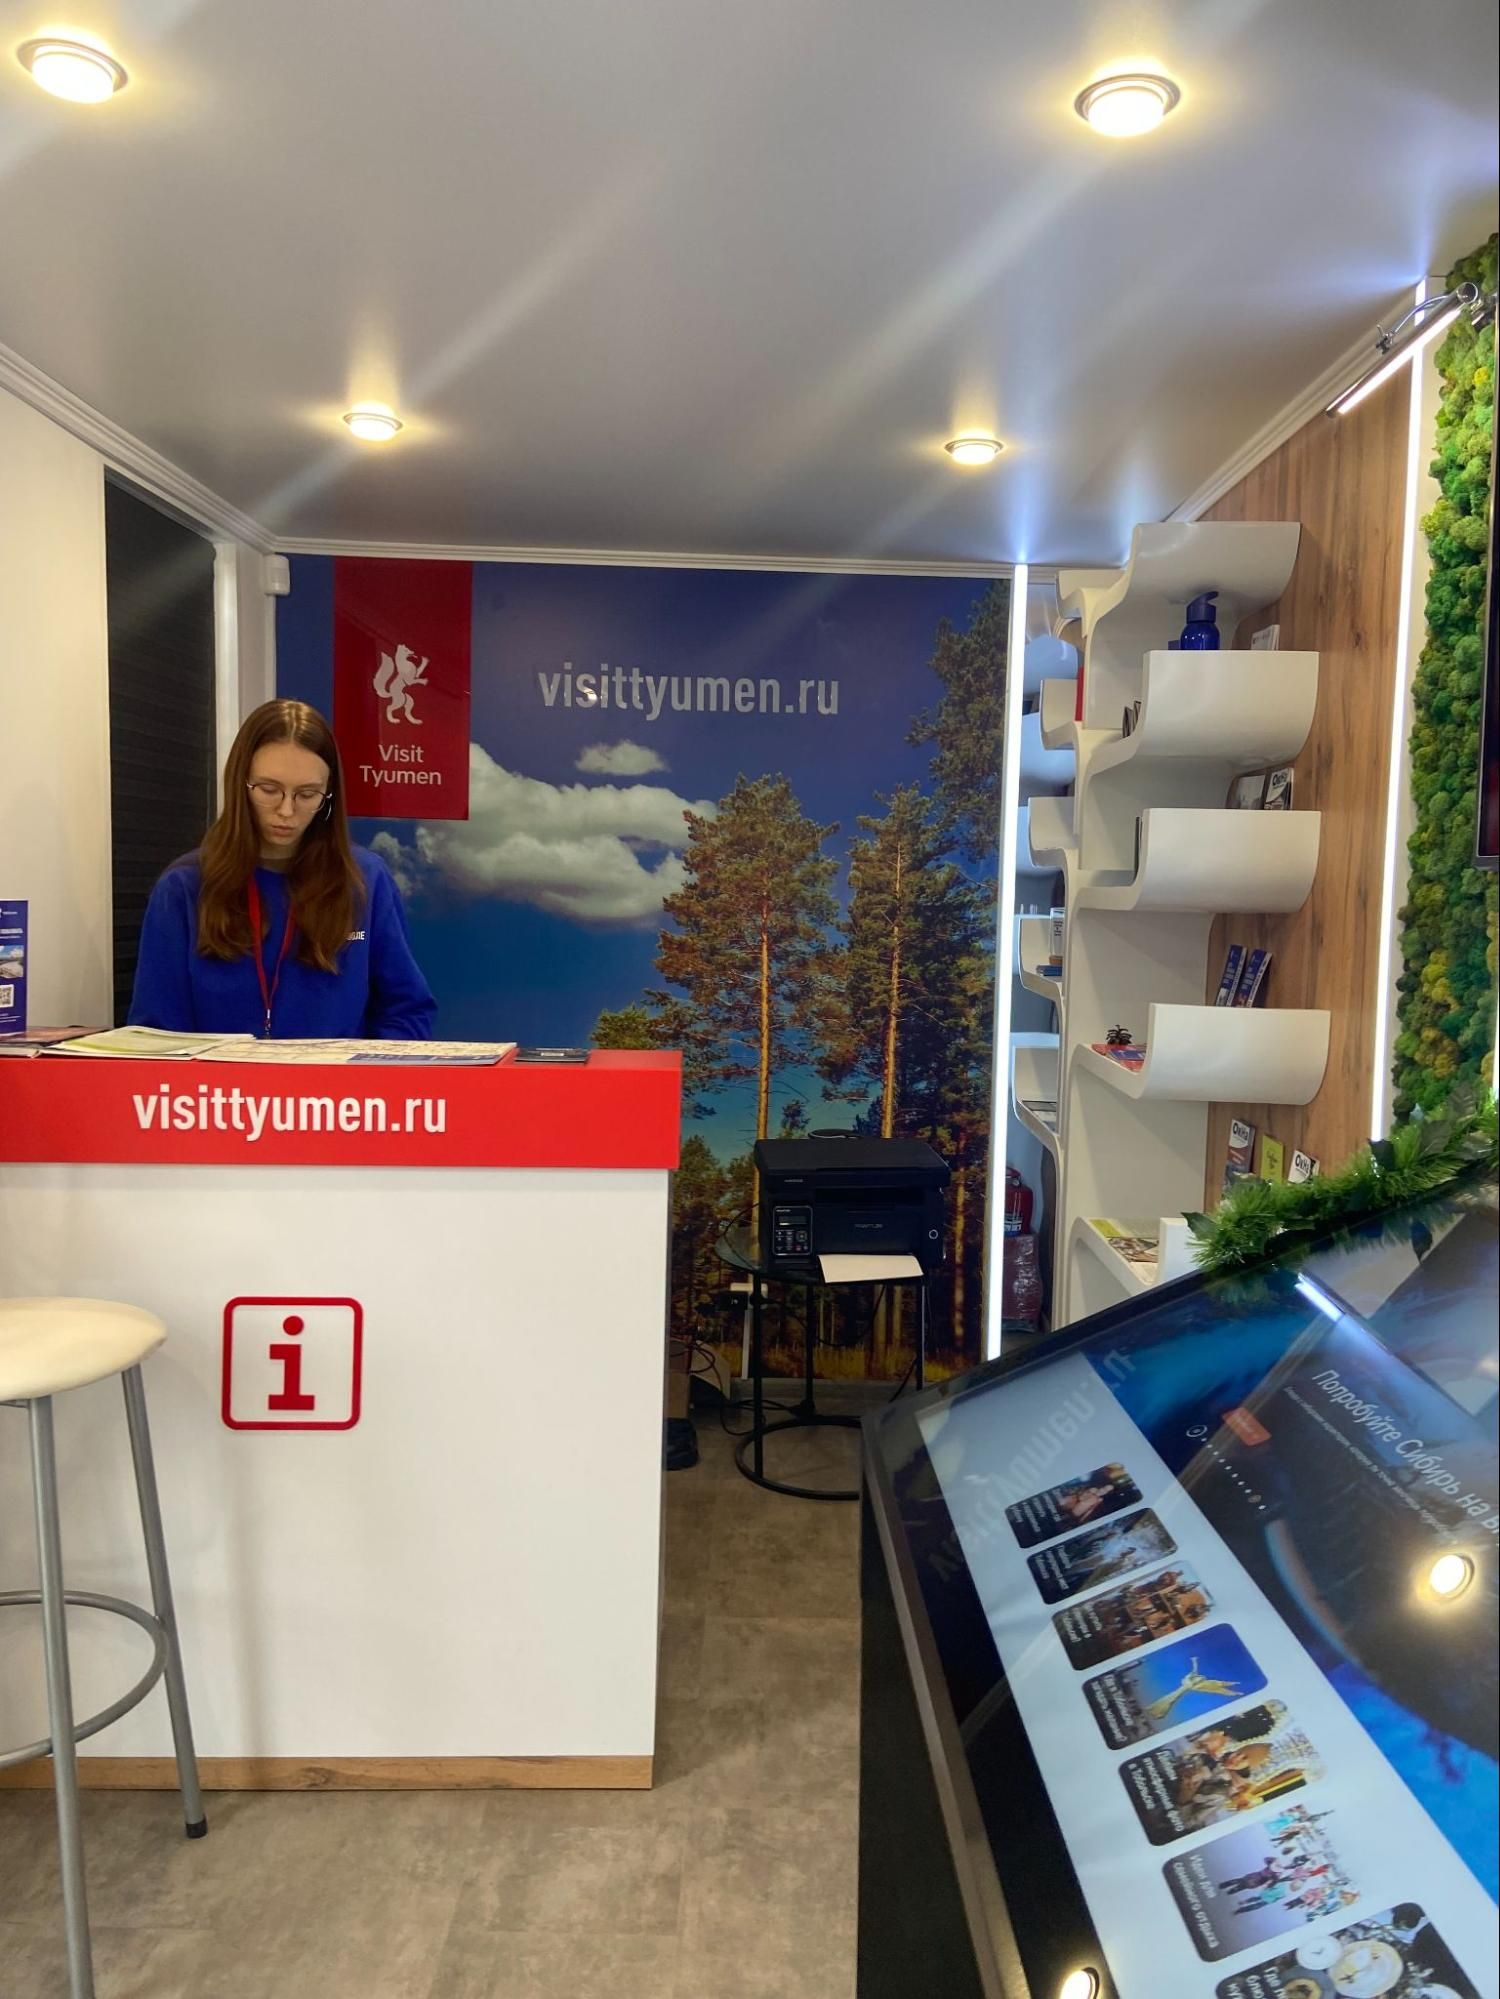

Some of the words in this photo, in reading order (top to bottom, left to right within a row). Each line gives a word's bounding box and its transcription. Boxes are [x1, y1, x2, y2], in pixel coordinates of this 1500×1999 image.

[537, 661, 839, 721] visittyumen.ru
[378, 744, 424, 763] Visit
[359, 765, 441, 788] Tyumen
[132, 1083, 446, 1142] visittyumen.ru
[1312, 1369, 1402, 1442] Попробуйте
[1395, 1439, 1461, 1495] Сибирь
[1456, 1493, 1490, 1517] на
[1167, 1810, 1184, 1831] фото
[1190, 1854, 1208, 1880] Идеи
[1199, 1881, 1216, 1898] для
[1173, 1862, 1202, 1911] семейного
[1195, 1911, 1219, 1948] отдыха
[1264, 1966, 1282, 1987] Где
